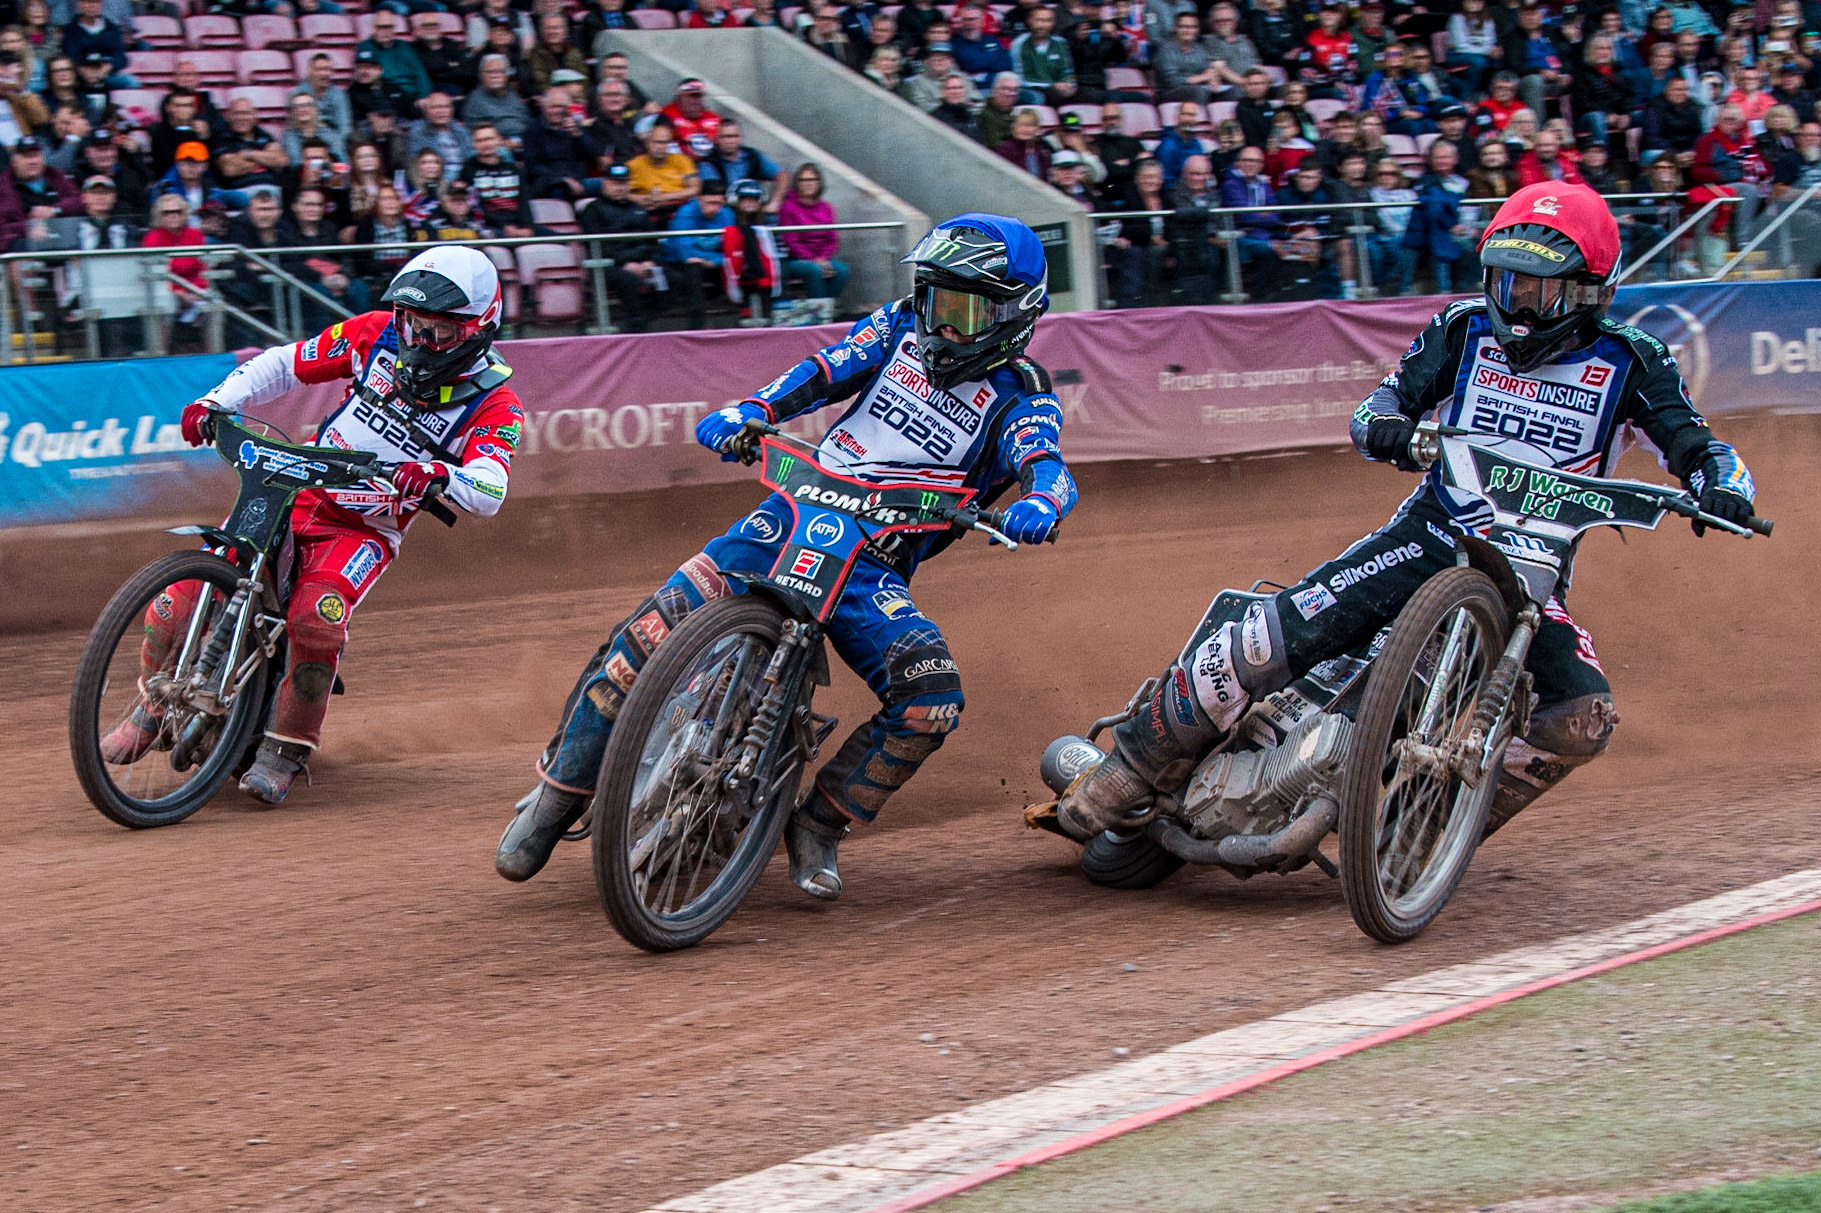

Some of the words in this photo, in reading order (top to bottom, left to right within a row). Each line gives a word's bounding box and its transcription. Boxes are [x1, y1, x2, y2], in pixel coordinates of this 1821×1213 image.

[888, 364, 930, 399] SPORTS
[928, 389, 979, 434] INSURE
[1477, 369, 1539, 399] SPORTS
[1538, 385, 1599, 413] INSURE
[1477, 394, 1538, 418] BRITISH
[1541, 411, 1586, 431] FINAL
[352, 401, 423, 460] 2022
[868, 394, 954, 463] 2022
[879, 385, 924, 419] BRITISH
[923, 414, 958, 445] FINAL
[1470, 406, 1584, 455] 2022
[10, 415, 130, 468] Quick
[130, 415, 190, 456] La
[336, 493, 387, 503] BRITISH
[1490, 465, 1509, 488] R
[1506, 468, 1526, 493] J
[1528, 470, 1615, 517] Warren
[1519, 493, 1562, 520] Ltd
[749, 514, 774, 538] ATPI
[811, 522, 838, 538] ATPI
[774, 573, 823, 598] BETARD
[1329, 541, 1425, 593] Silkolene
[1299, 588, 1328, 612] FUCHS
